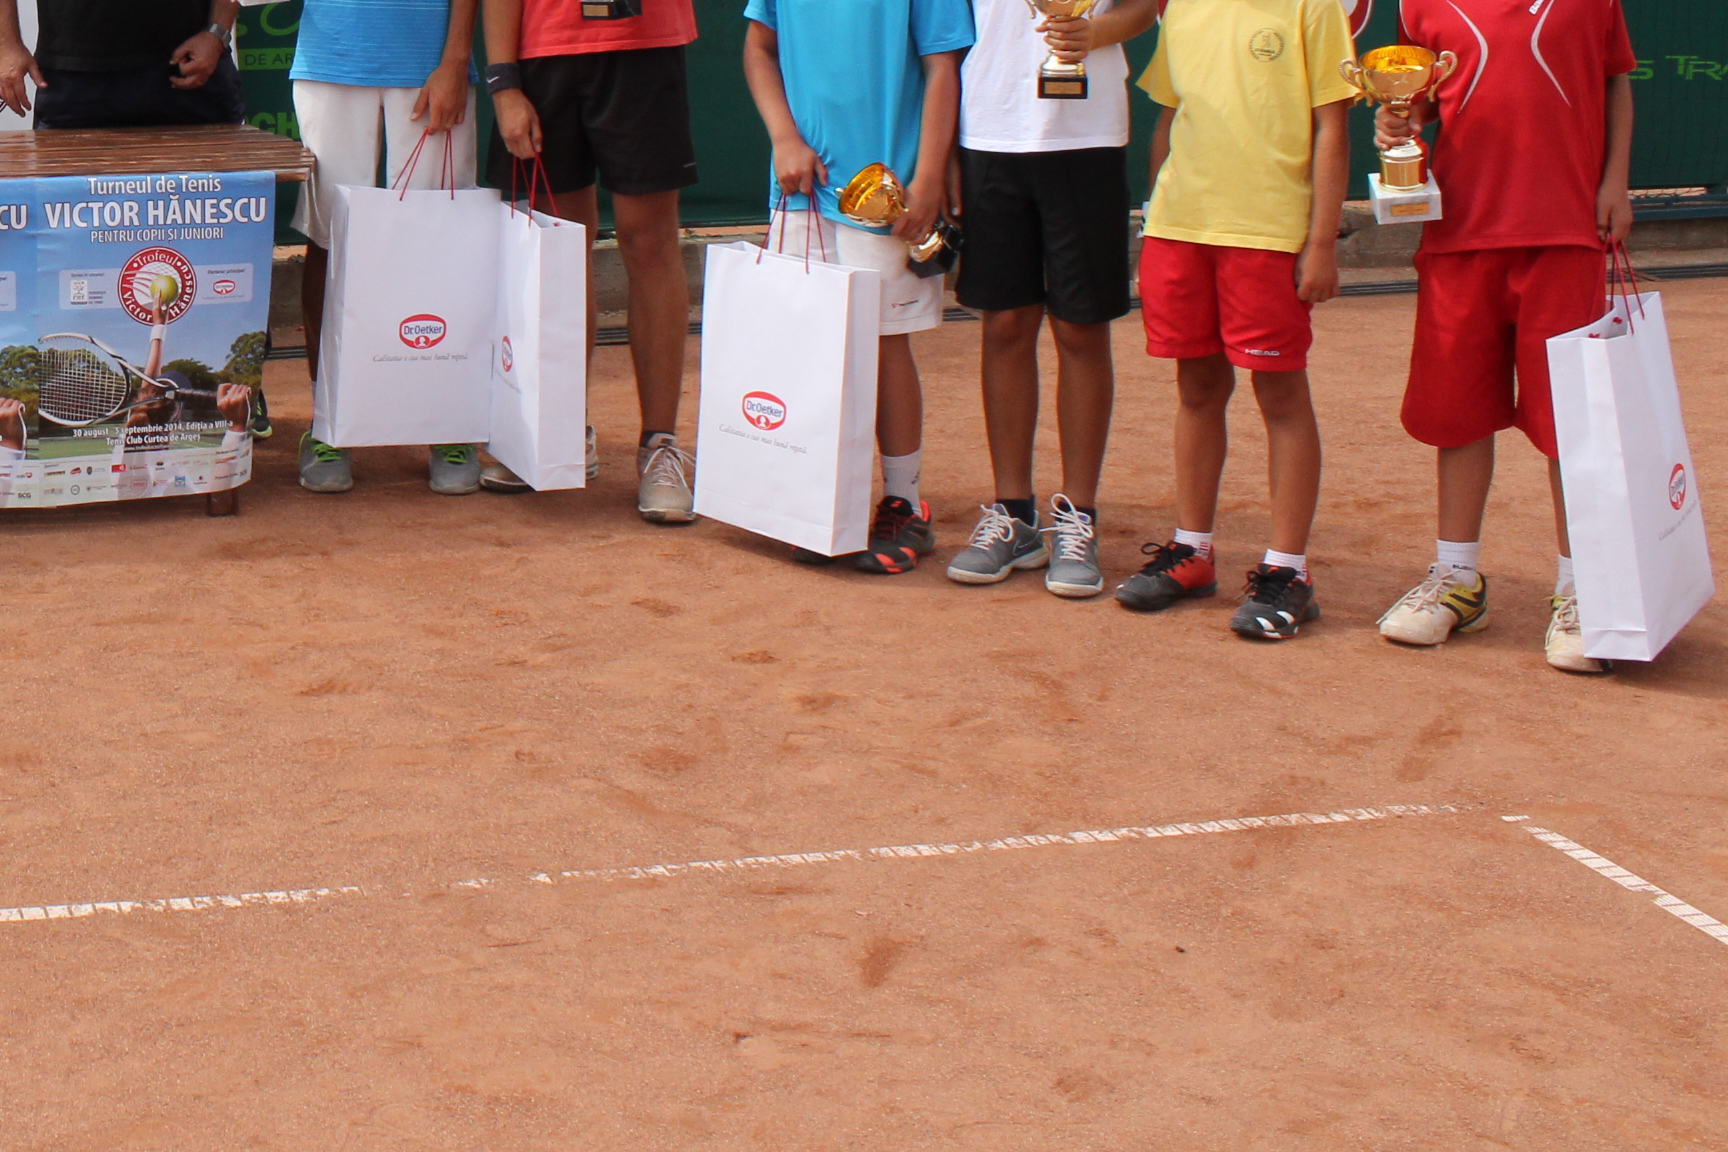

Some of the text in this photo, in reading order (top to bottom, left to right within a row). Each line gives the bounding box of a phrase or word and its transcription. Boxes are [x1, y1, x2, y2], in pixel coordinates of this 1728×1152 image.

[244, 54, 266, 65] DE
[88, 174, 221, 195] Turneul de Tenis
[44, 194, 267, 229] VICTOR HĂNESCU
[136, 250, 179, 267] Trofeul
[122, 291, 154, 321] Victor
[1245, 348, 1280, 356] HEAD
